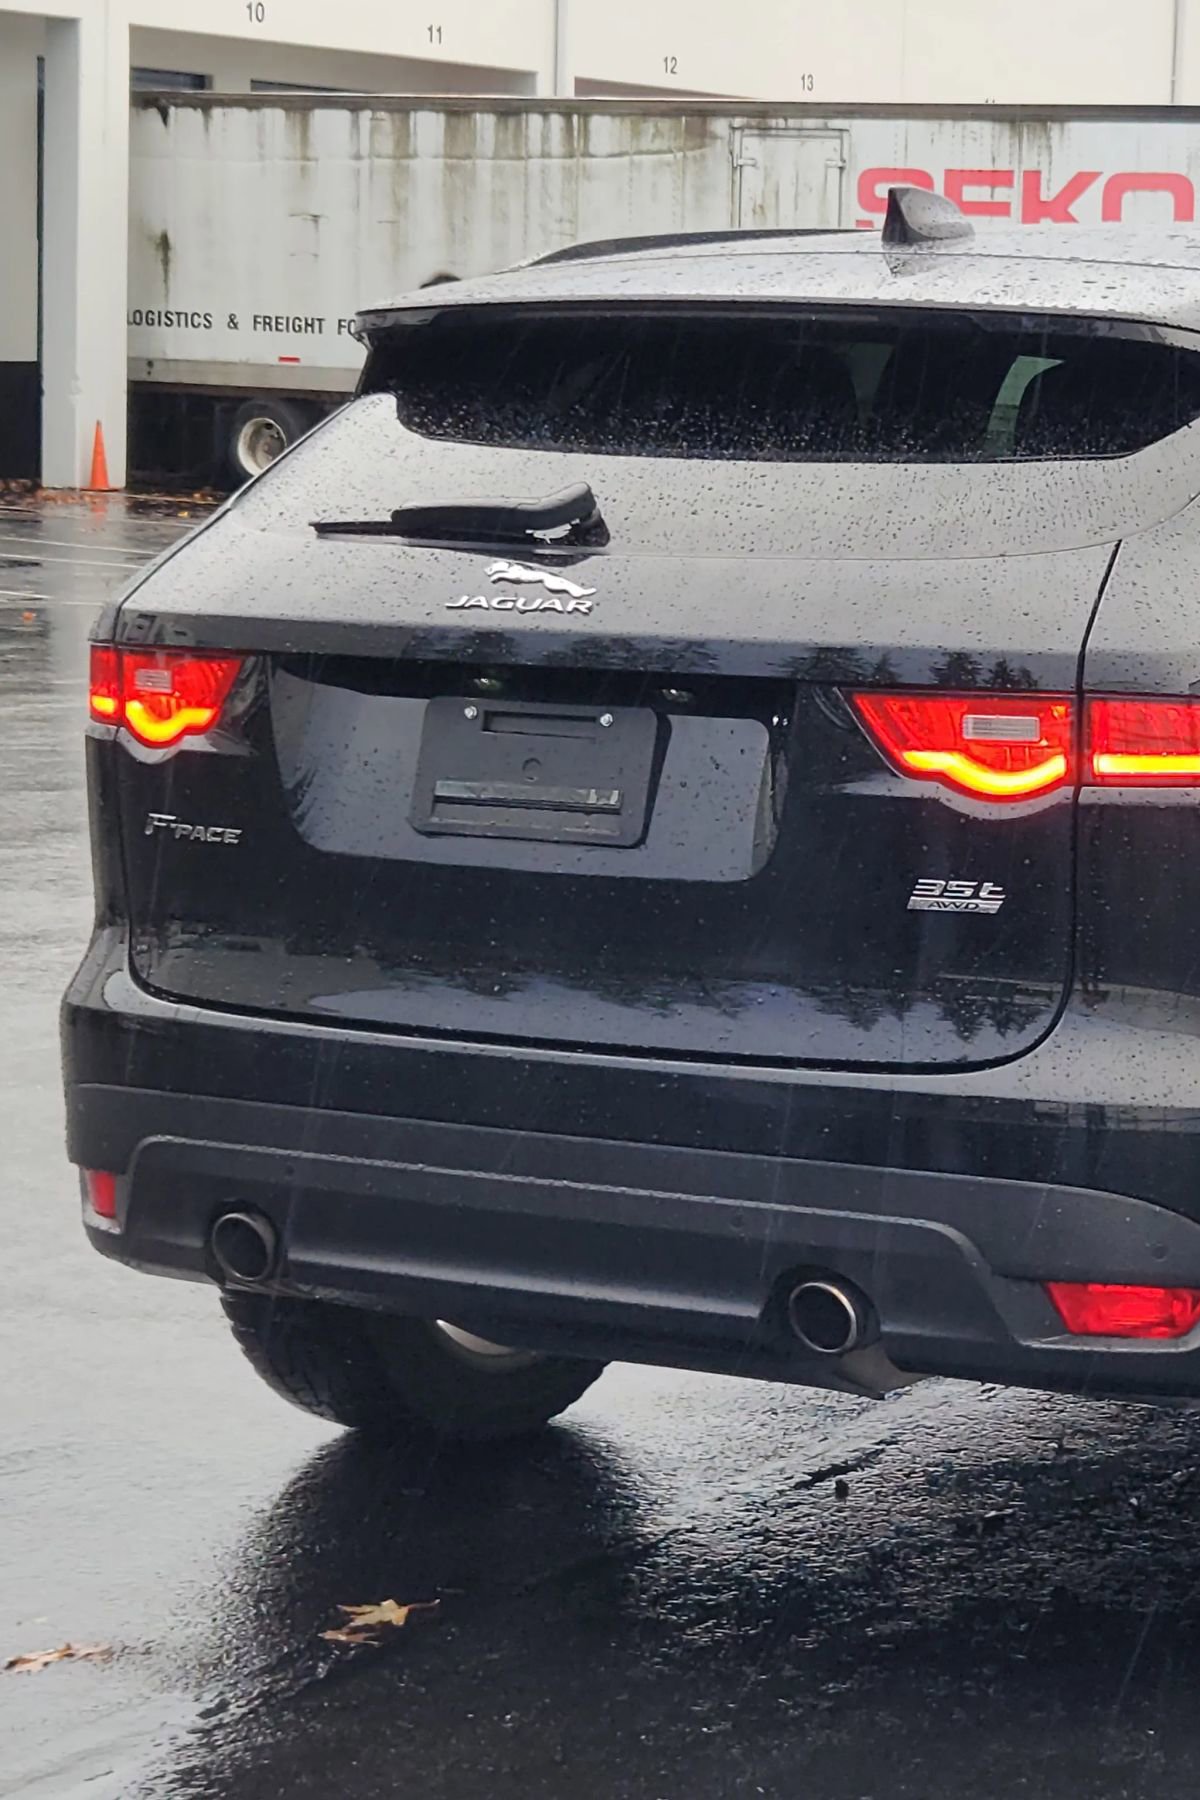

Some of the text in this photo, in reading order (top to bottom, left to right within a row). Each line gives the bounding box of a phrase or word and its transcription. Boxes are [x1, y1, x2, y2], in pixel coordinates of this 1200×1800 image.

[246, 2, 265, 23] 10
[427, 24, 442, 44] 11
[663, 56, 678, 75] 12
[800, 73, 814, 91] 13
[127, 309, 213, 329] LOGISTICS
[227, 313, 239, 330] &
[253, 314, 325, 334] FREIGHT
[444, 595, 594, 616] JAGUAR
[912, 878, 1006, 899] 35t
[927, 900, 980, 911] AWD
